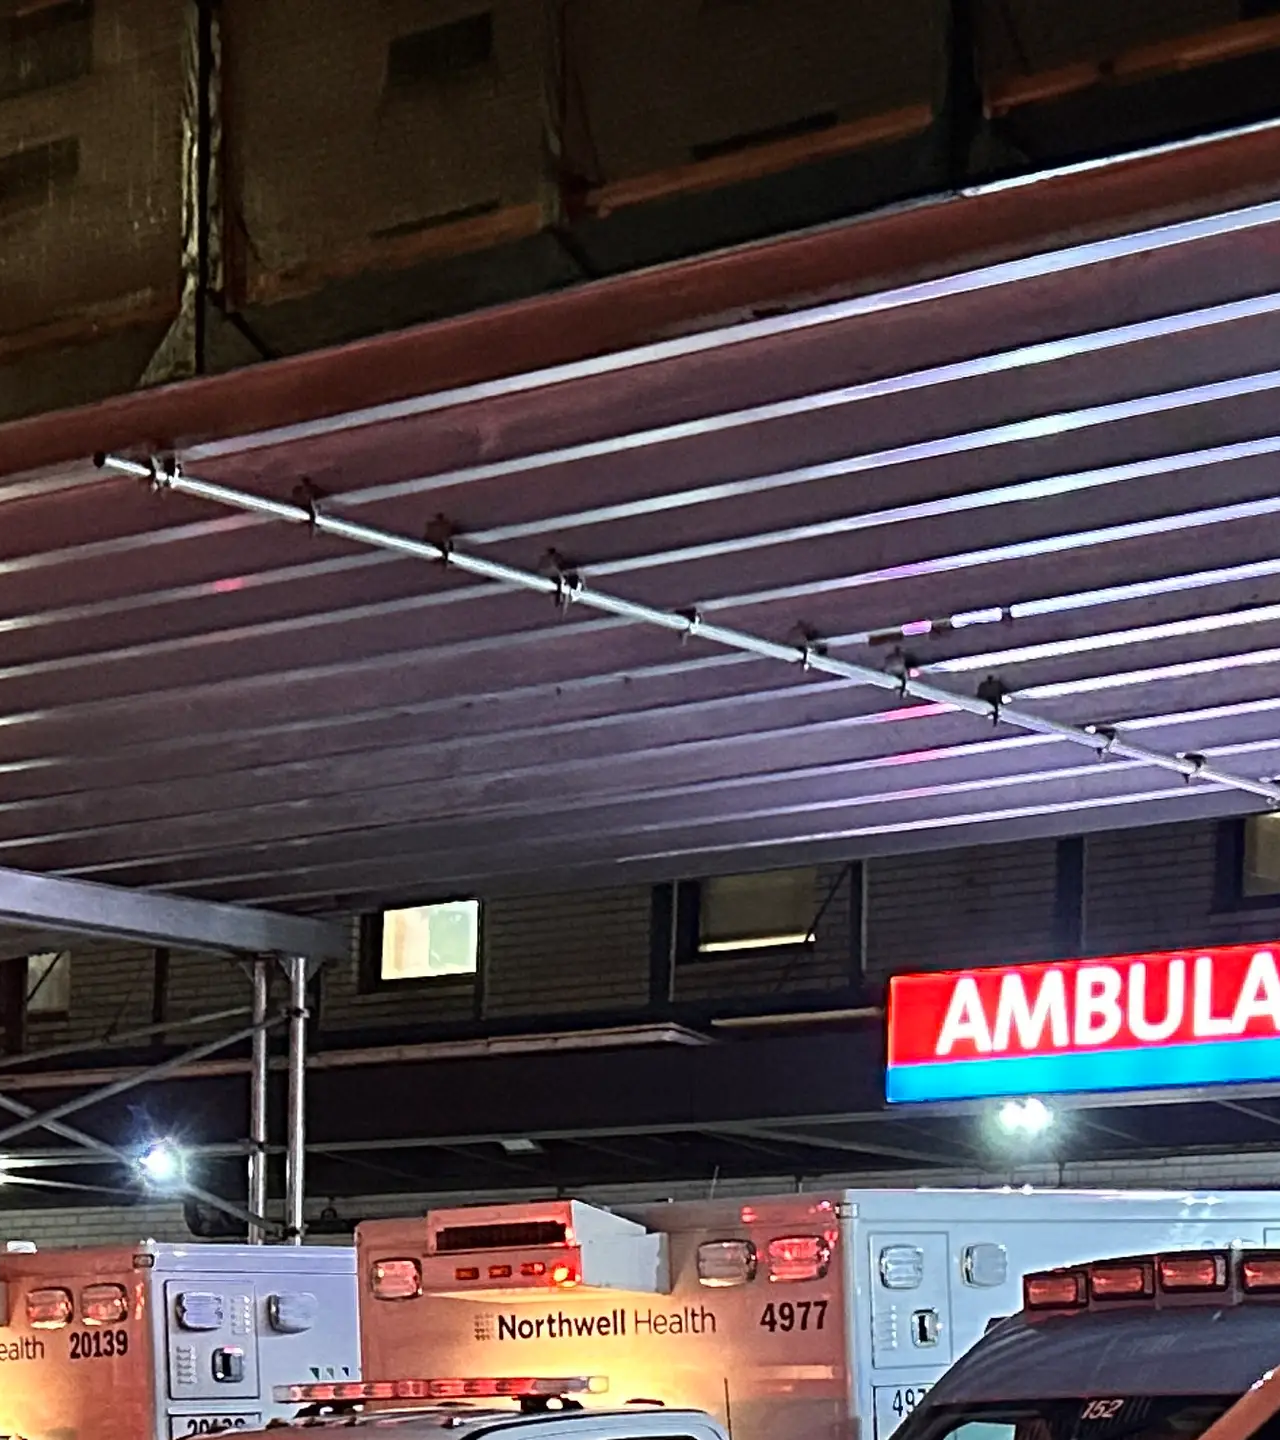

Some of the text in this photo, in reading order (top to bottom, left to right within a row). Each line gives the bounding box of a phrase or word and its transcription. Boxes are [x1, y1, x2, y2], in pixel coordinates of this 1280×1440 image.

[498, 1306, 716, 1341] Northwell Health
[760, 1300, 828, 1332] 4977
[70, 1330, 128, 1360] 20139
[1081, 1399, 1124, 1420] 152
